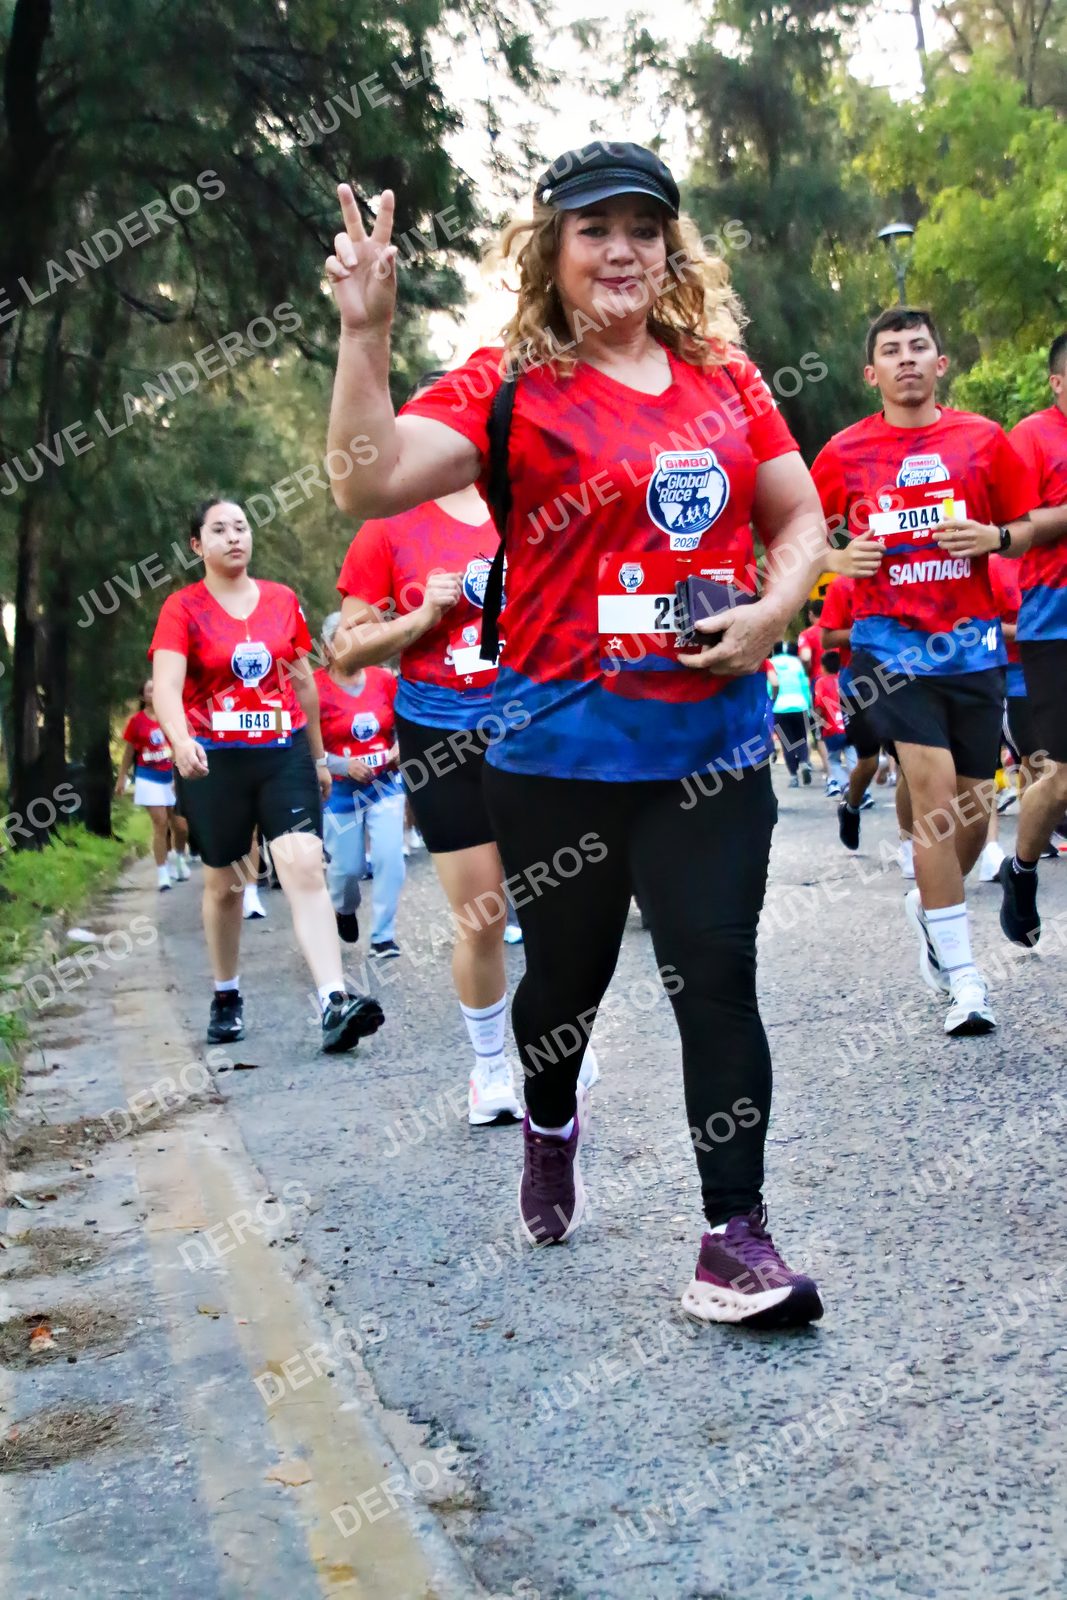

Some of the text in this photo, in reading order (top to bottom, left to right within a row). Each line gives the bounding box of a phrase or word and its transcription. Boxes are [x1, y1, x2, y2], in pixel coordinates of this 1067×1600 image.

[667, 473, 710, 490] Global
[658, 488, 693, 503] Race
[897, 506, 940, 530] 2044
[673, 536, 699, 548] 2026
[888, 558, 971, 586] SANTIAGO
[239, 713, 270, 729] 1648
